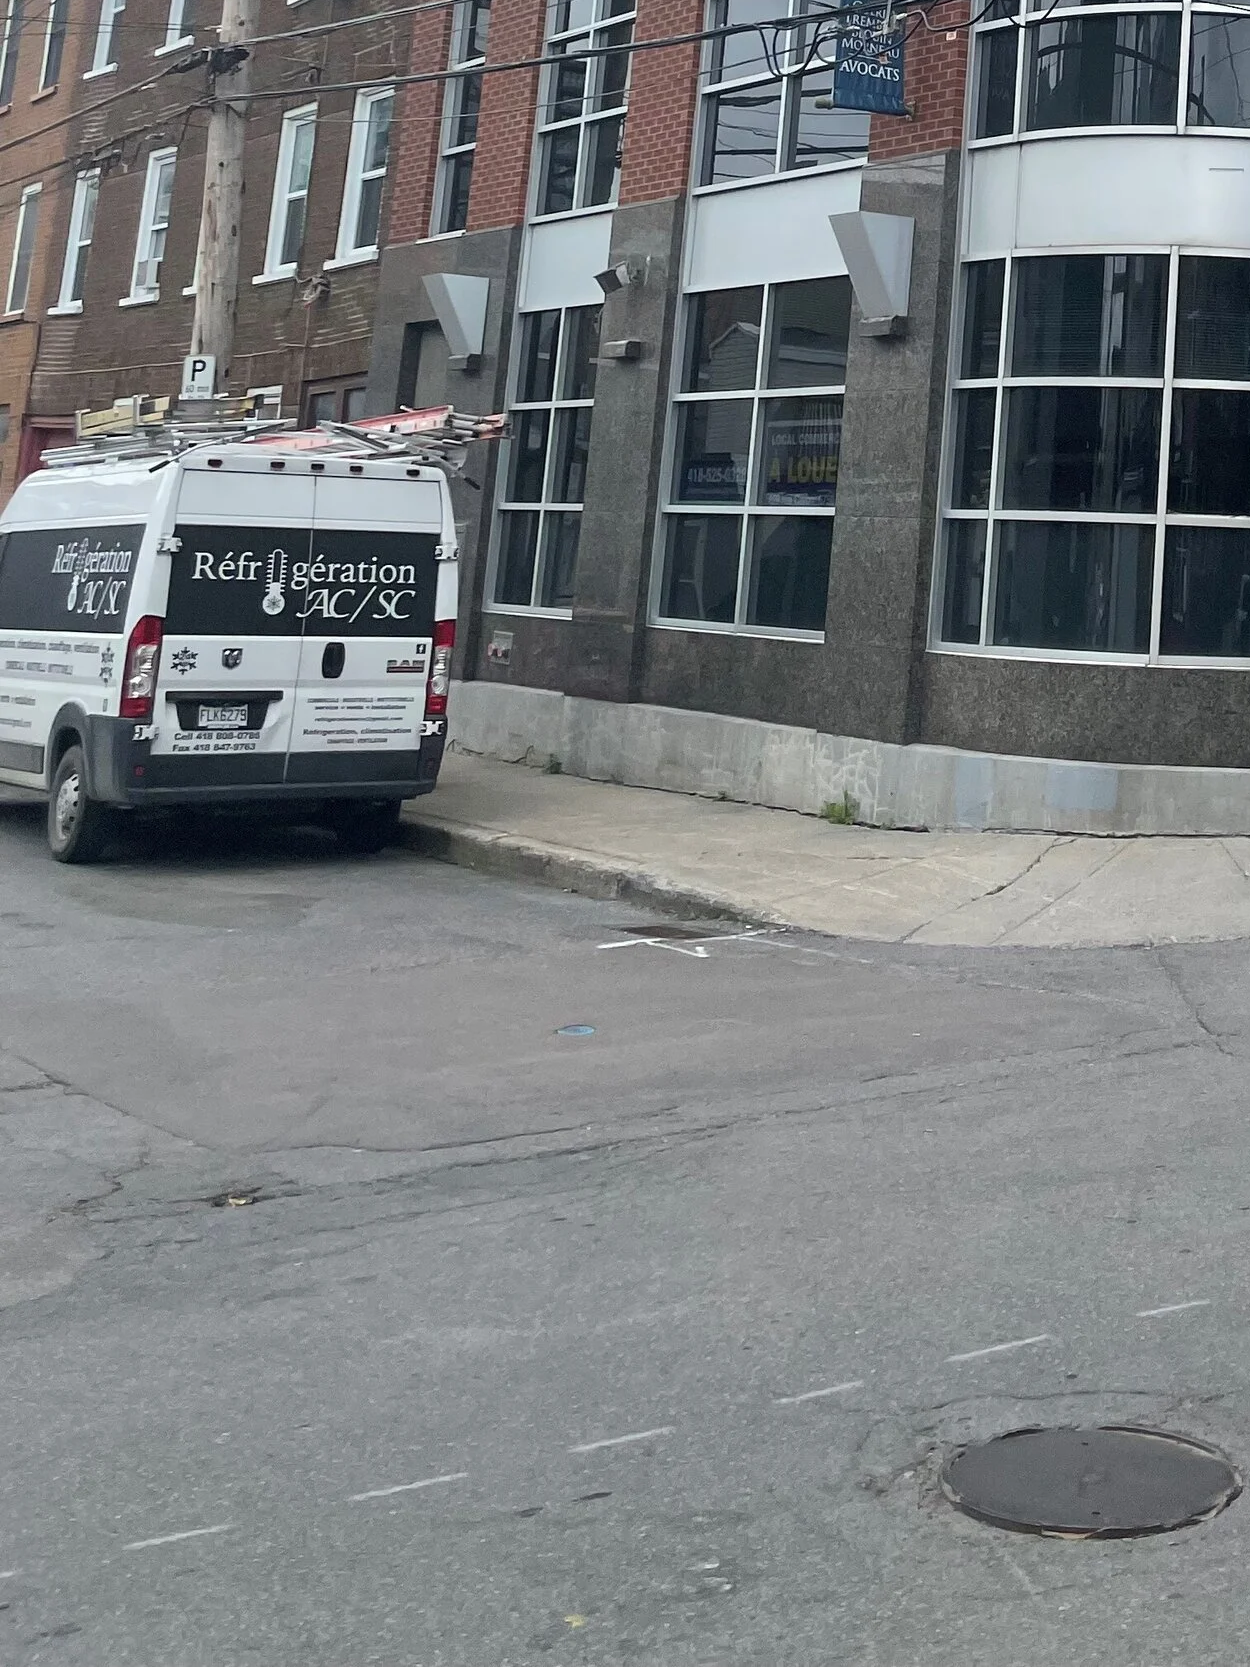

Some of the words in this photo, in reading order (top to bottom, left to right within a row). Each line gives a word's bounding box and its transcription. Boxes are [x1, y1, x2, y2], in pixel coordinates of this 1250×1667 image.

[839, 59, 900, 82] AVOCATS
[191, 359, 207, 382] P
[296, 585, 416, 623] AC/SC
[200, 708, 247, 722] FLK6279
[172, 744, 190, 752] Fax
